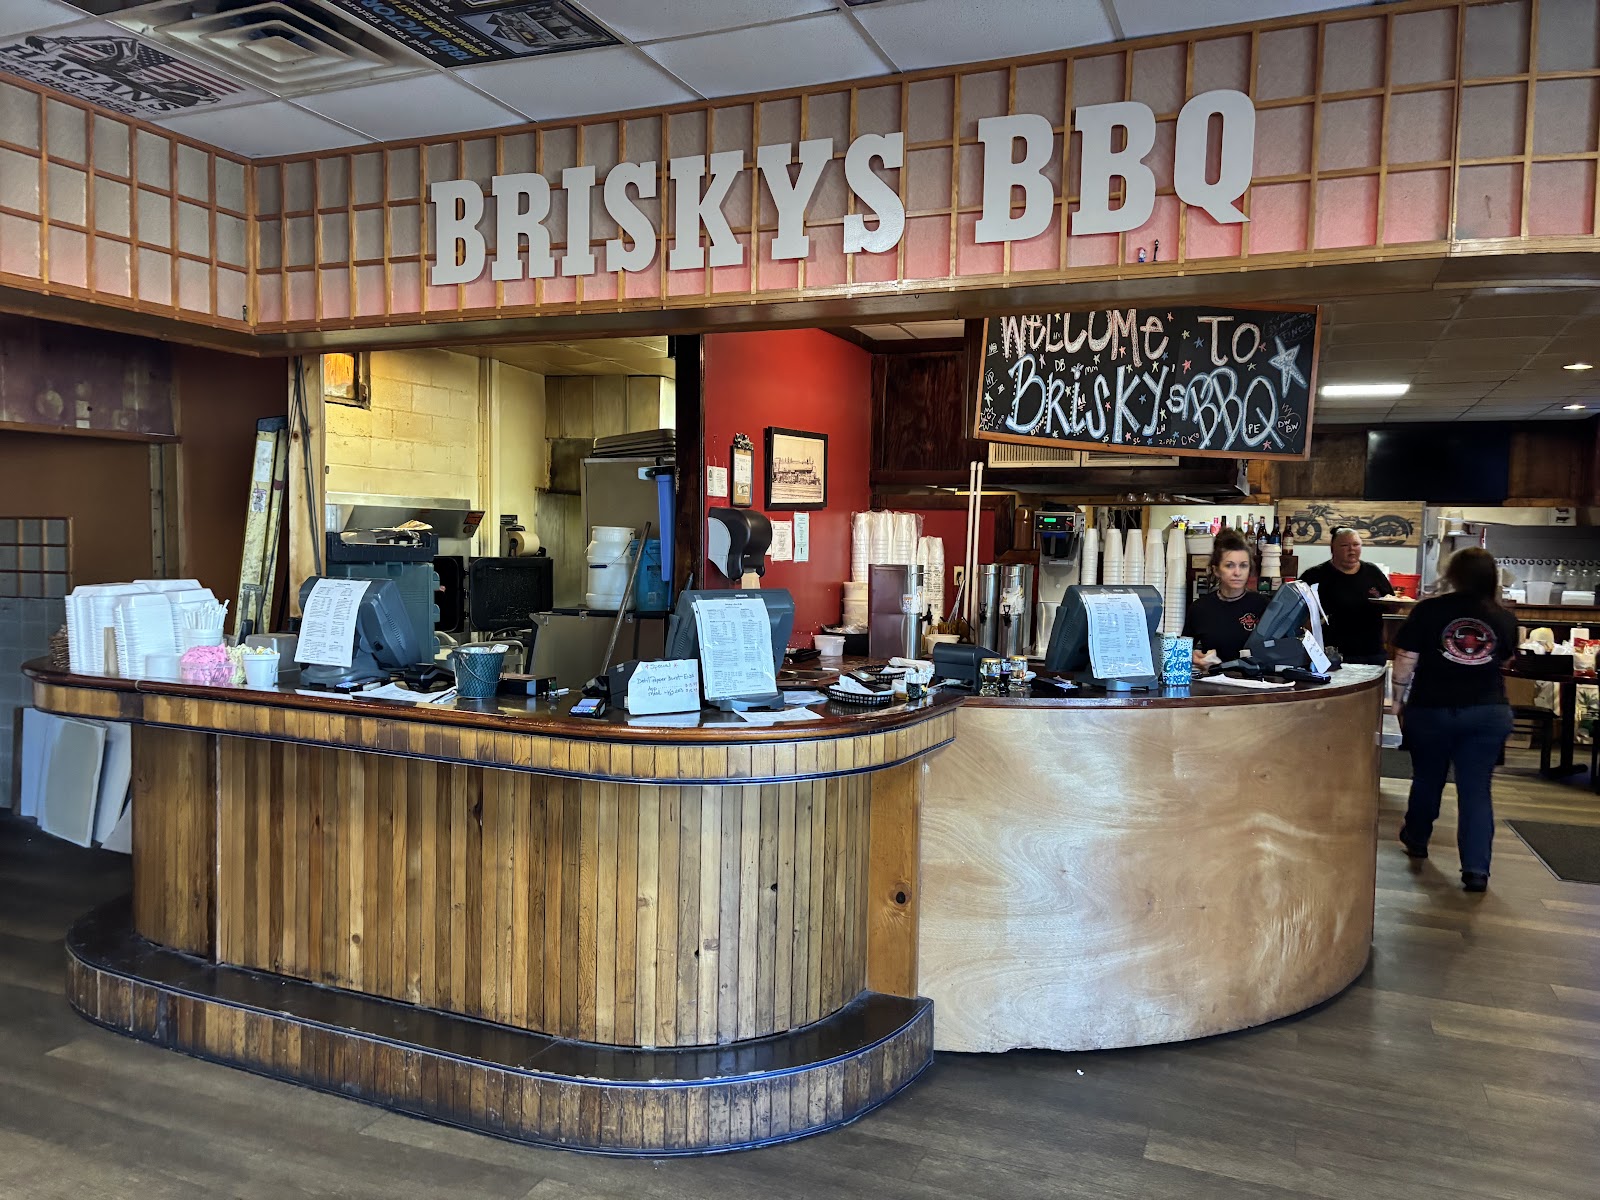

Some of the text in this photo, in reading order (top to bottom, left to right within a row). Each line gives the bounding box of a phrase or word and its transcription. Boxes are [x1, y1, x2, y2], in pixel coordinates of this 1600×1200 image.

[381, 24, 411, 40] Your
[423, 20, 456, 38] SUPER
[409, 40, 438, 55] Send
[428, 40, 473, 60] 1880
[0, 43, 182, 112] HAGAN'S
[430, 88, 1257, 286] BRISKYS BBQ
